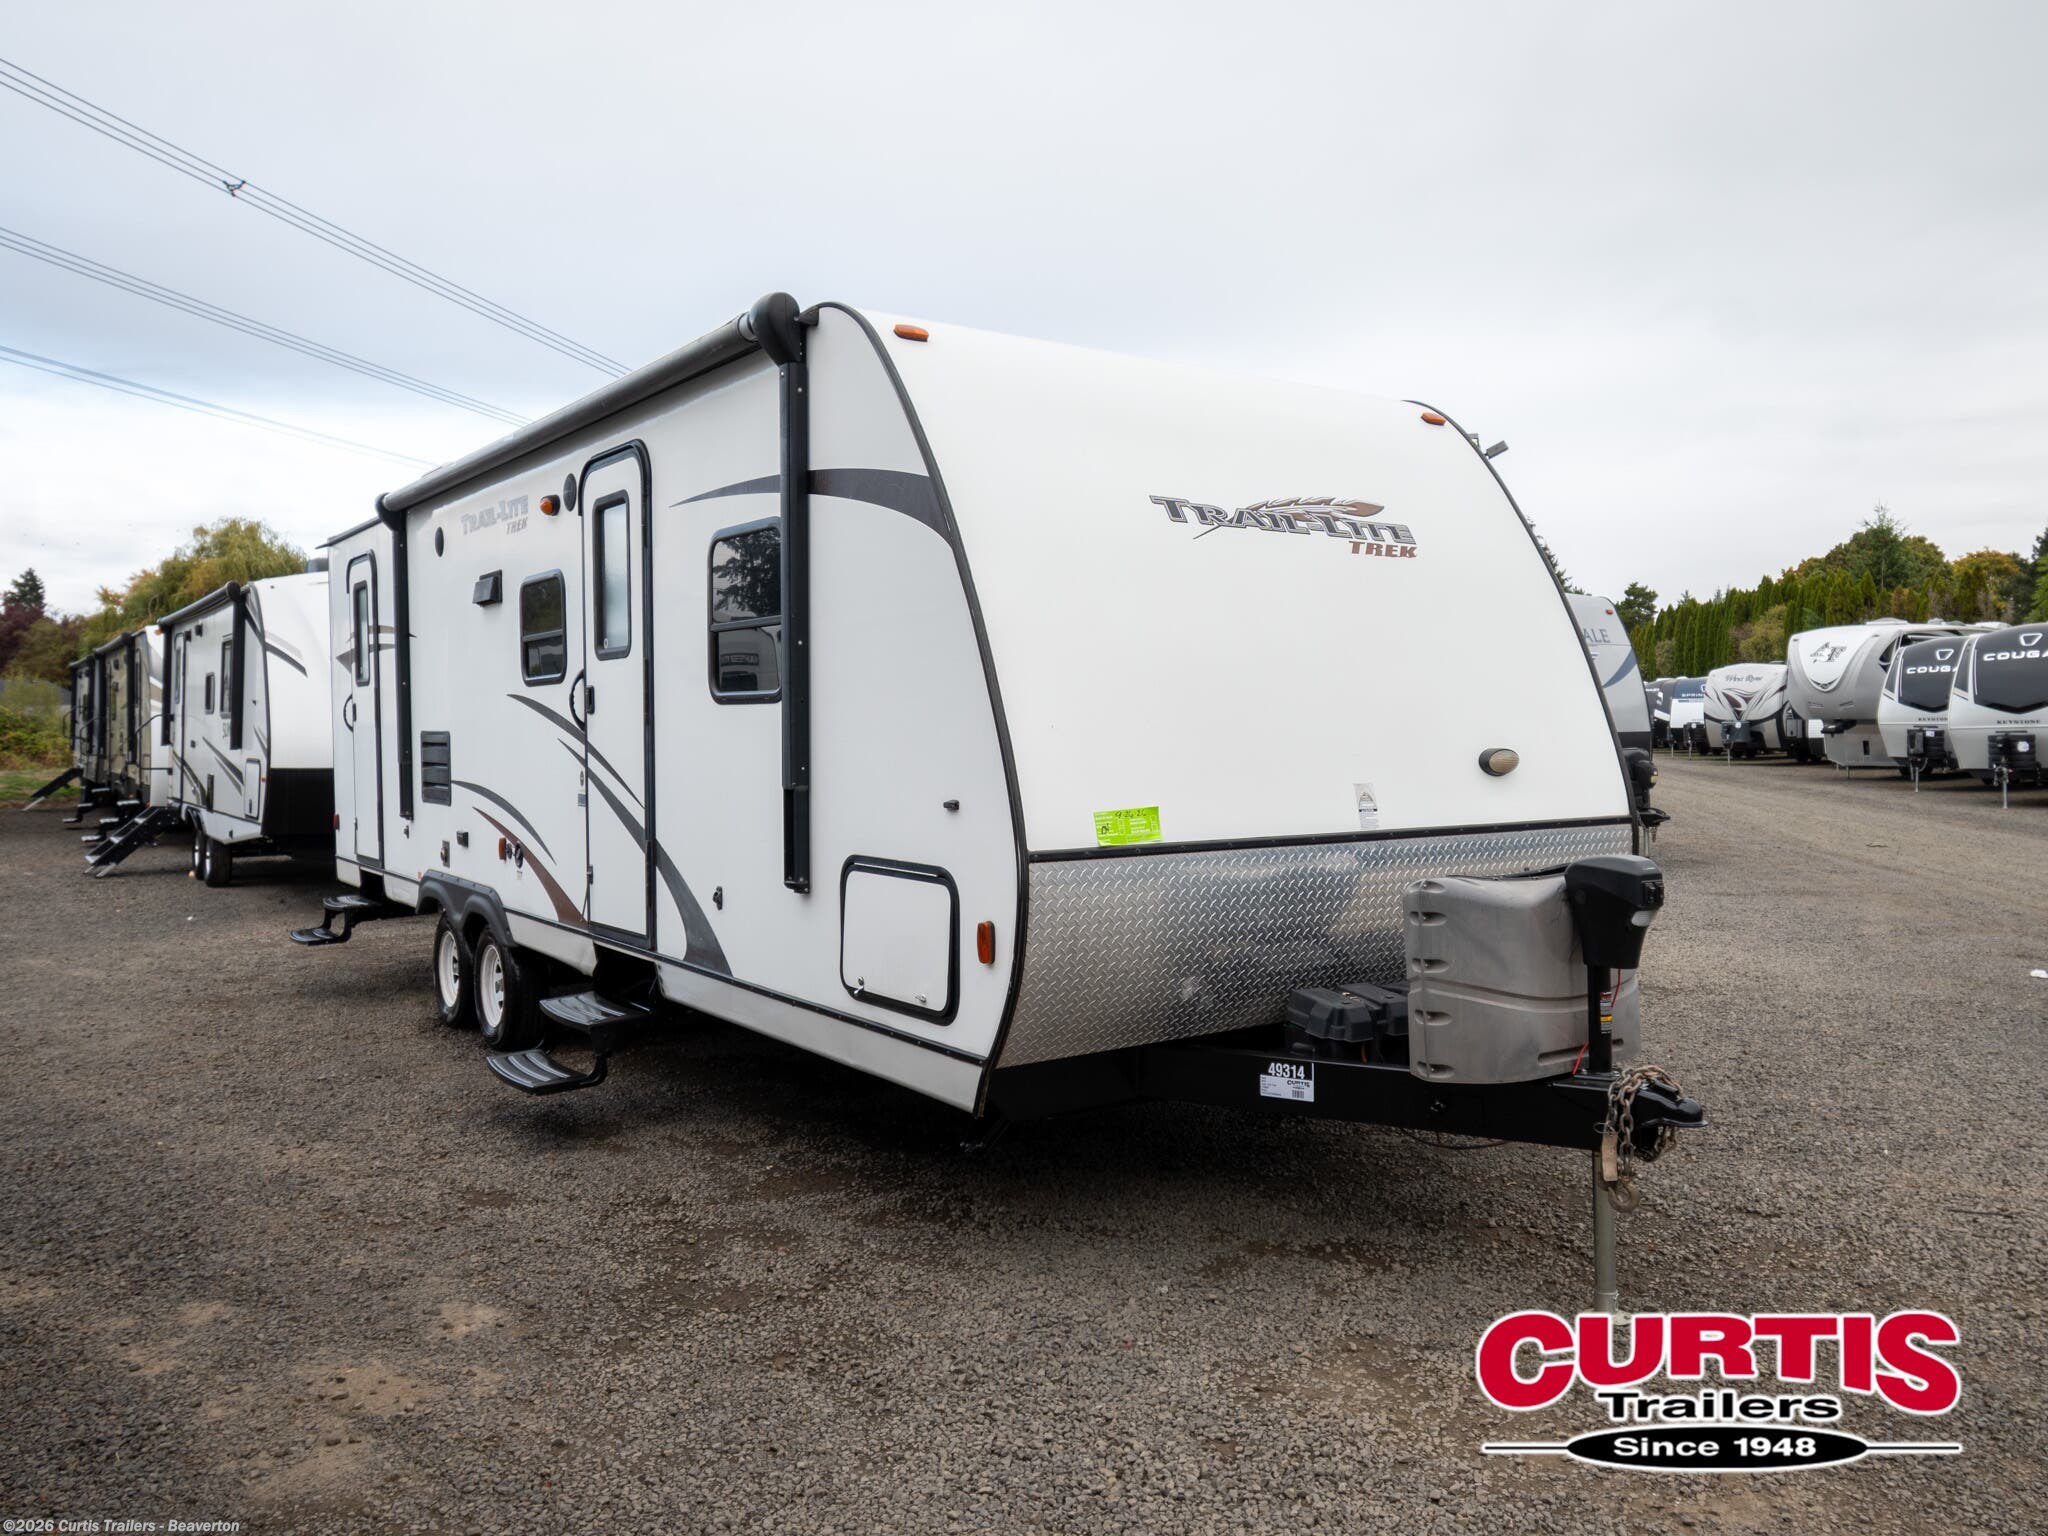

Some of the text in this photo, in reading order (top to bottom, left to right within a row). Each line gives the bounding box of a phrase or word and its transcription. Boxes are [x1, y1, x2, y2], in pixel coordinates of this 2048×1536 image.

[506, 517, 528, 535] TREK
[1349, 540, 1417, 558] TREK
[1268, 1062, 1305, 1079] 49314
